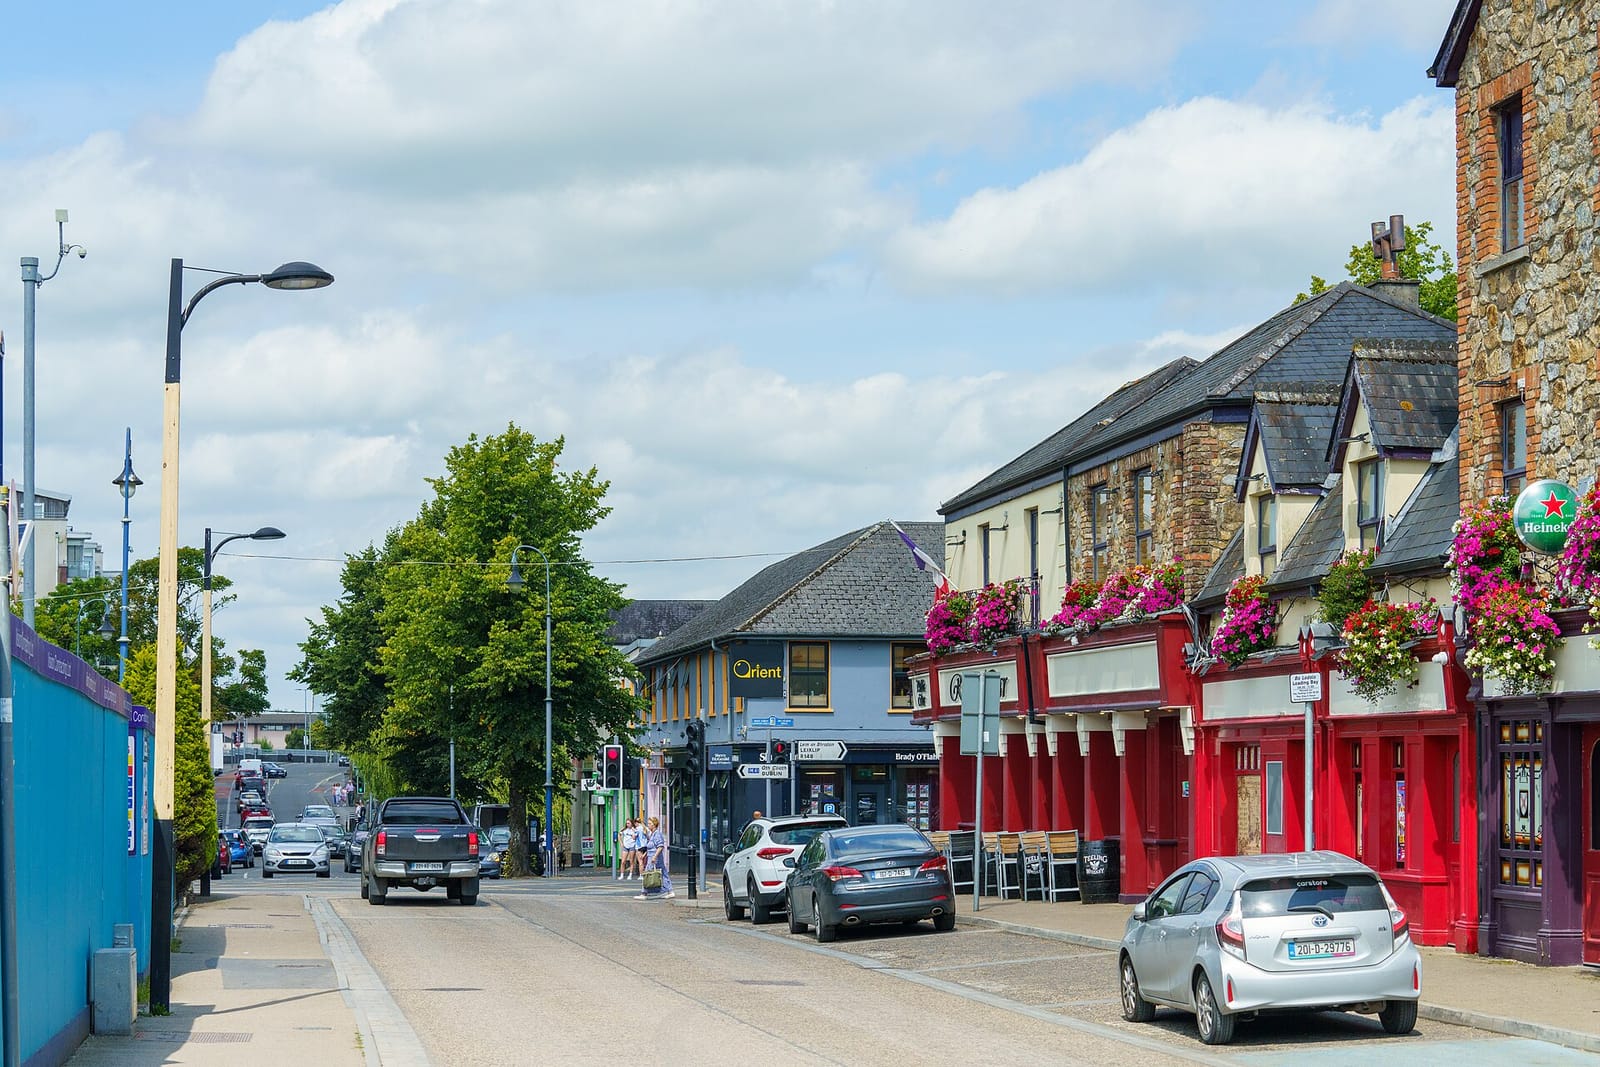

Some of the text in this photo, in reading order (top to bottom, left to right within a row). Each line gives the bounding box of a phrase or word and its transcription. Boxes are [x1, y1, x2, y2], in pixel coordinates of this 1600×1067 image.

[1524, 522, 1569, 533] Heinek
[733, 659, 782, 678] Orient
[895, 752, 915, 762] Brady
[1083, 854, 1108, 864] TEELING
[1296, 879, 1328, 887] carstore
[1297, 941, 1351, 956] 201-D-29776
